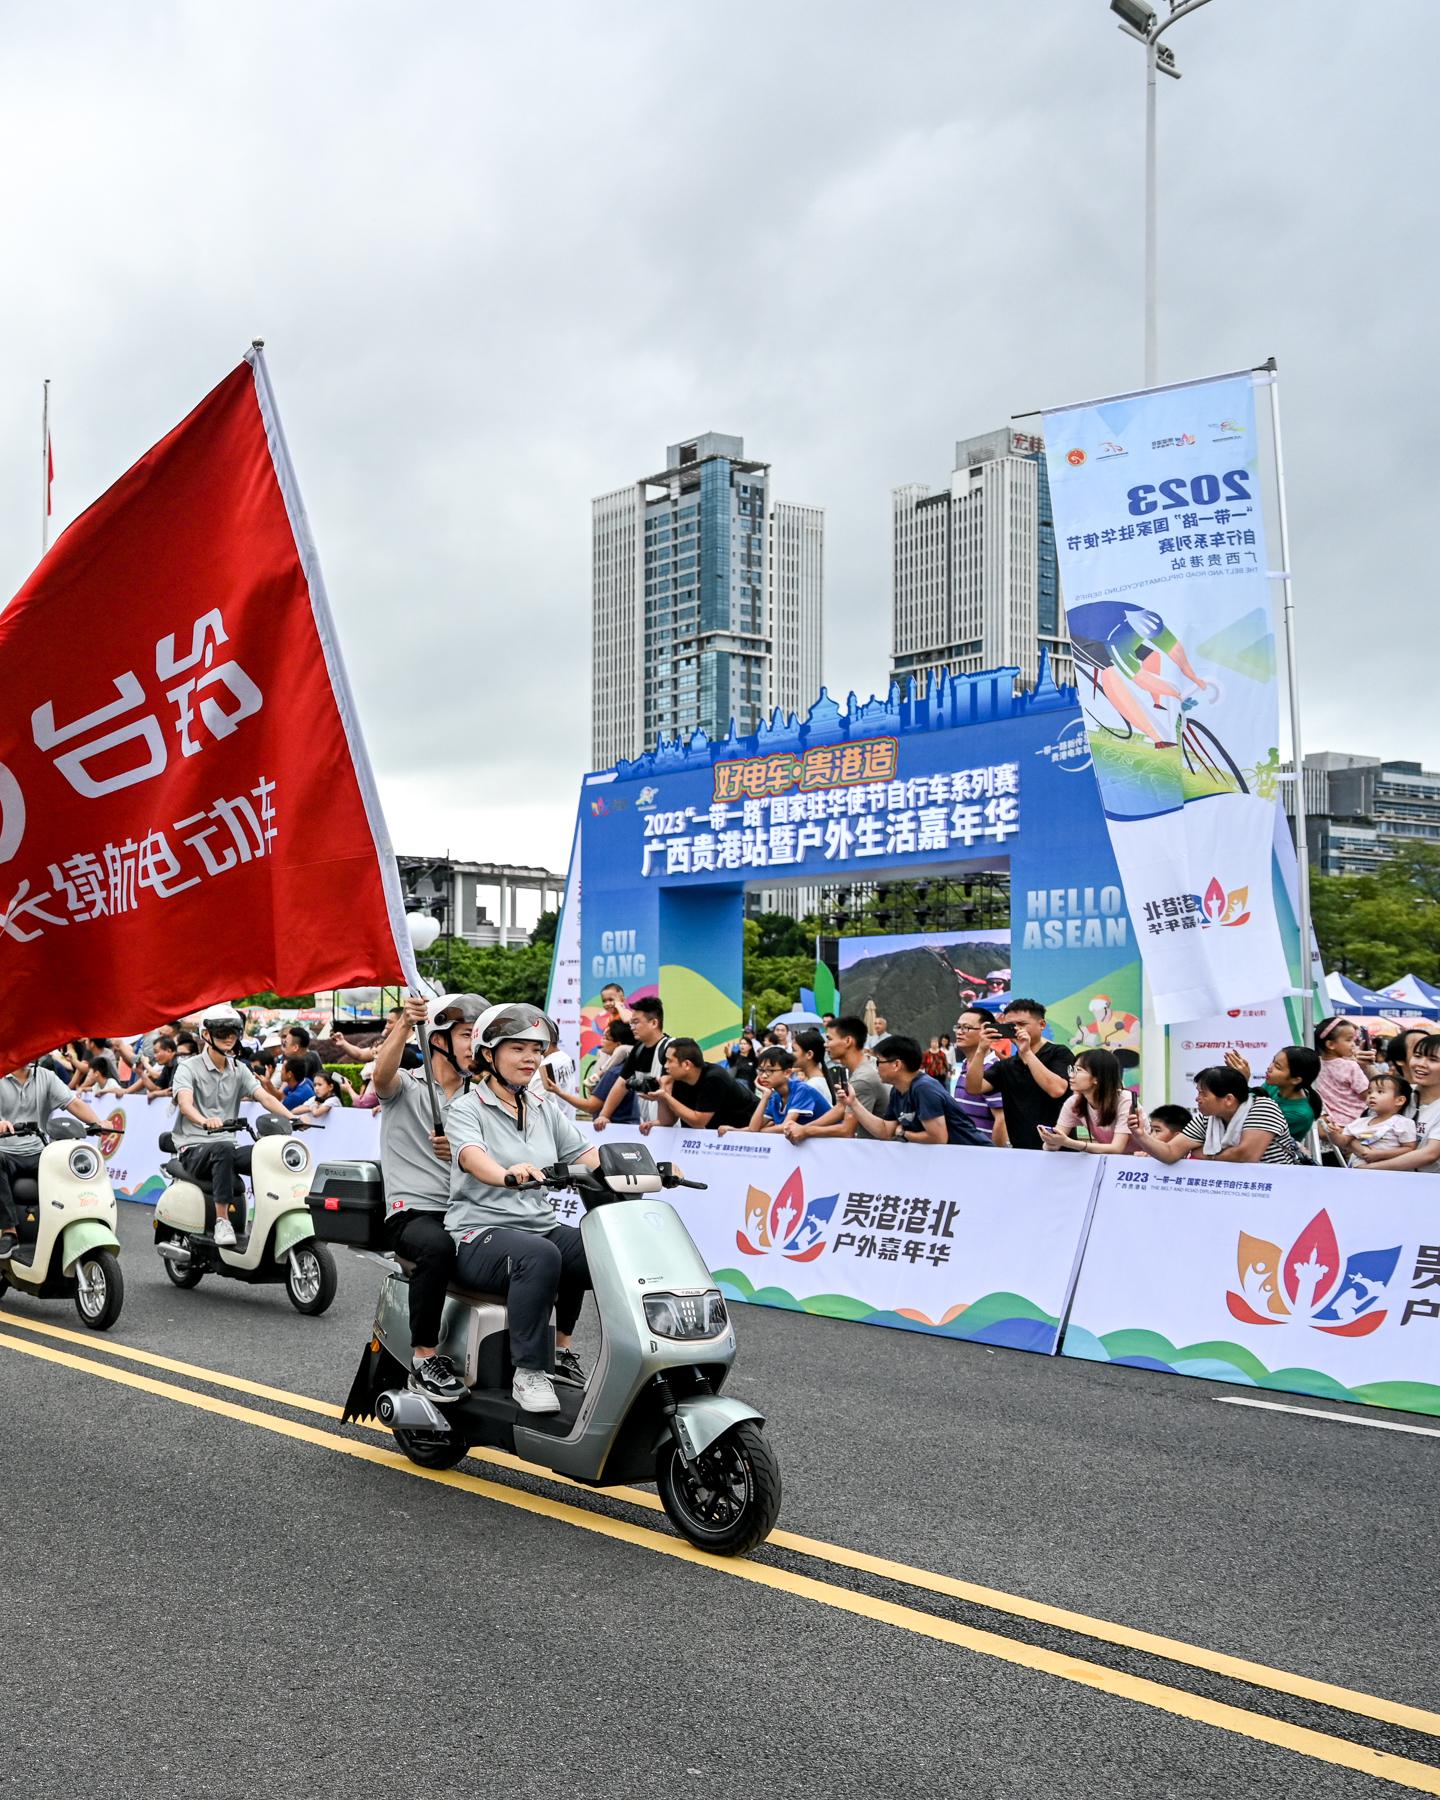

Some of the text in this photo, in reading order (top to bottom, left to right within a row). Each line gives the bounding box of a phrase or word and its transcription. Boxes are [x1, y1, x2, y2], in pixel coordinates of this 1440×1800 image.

[641, 799, 1020, 877] 广西贵港站暨户外生活嘉年华
[1027, 886, 1122, 919] HELLO
[601, 930, 636, 954] GUI
[1023, 917, 1127, 949] ASEAN
[592, 954, 646, 978] GANG
[1117, 1171, 1149, 1182] 2023
[842, 1192, 960, 1239] 贵港港北
[832, 1233, 951, 1267] 户外嘉年华
